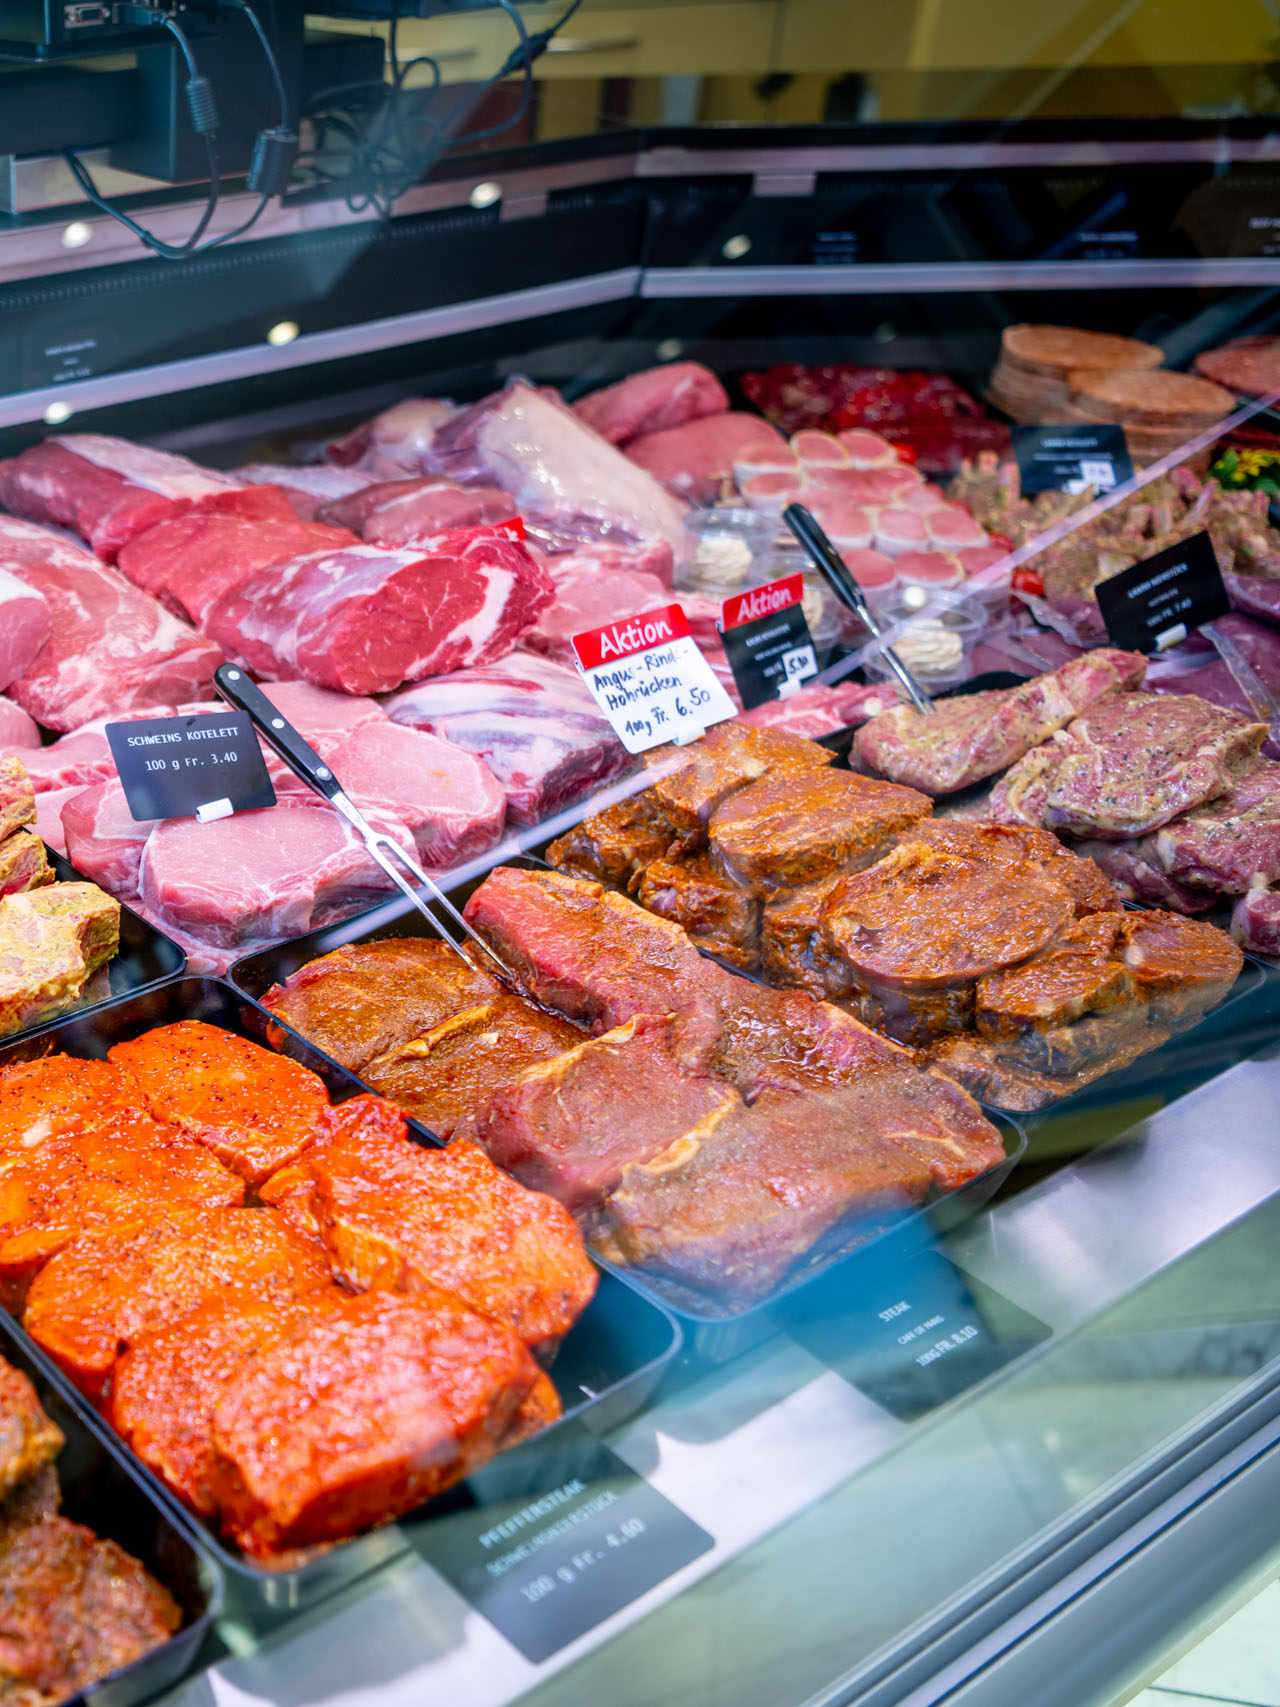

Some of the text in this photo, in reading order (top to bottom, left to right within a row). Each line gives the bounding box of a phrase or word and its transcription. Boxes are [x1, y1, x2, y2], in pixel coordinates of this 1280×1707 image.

[737, 586, 792, 623] Aktion
[600, 618, 673, 659] Aktion
[651, 706, 669, 724] Fr.
[675, 687, 710, 716] 6.50
[127, 727, 239, 747] SCHWEINS KOTELETT
[145, 751, 238, 771] 100 g Fr. 3.40
[878, 1301, 911, 1322] STEAK
[916, 1325, 978, 1367] 100G FR. 8.10
[479, 1478, 586, 1549] PFEFFERSTEAK
[521, 1517, 647, 1602] 100 g Fr. 4.60
